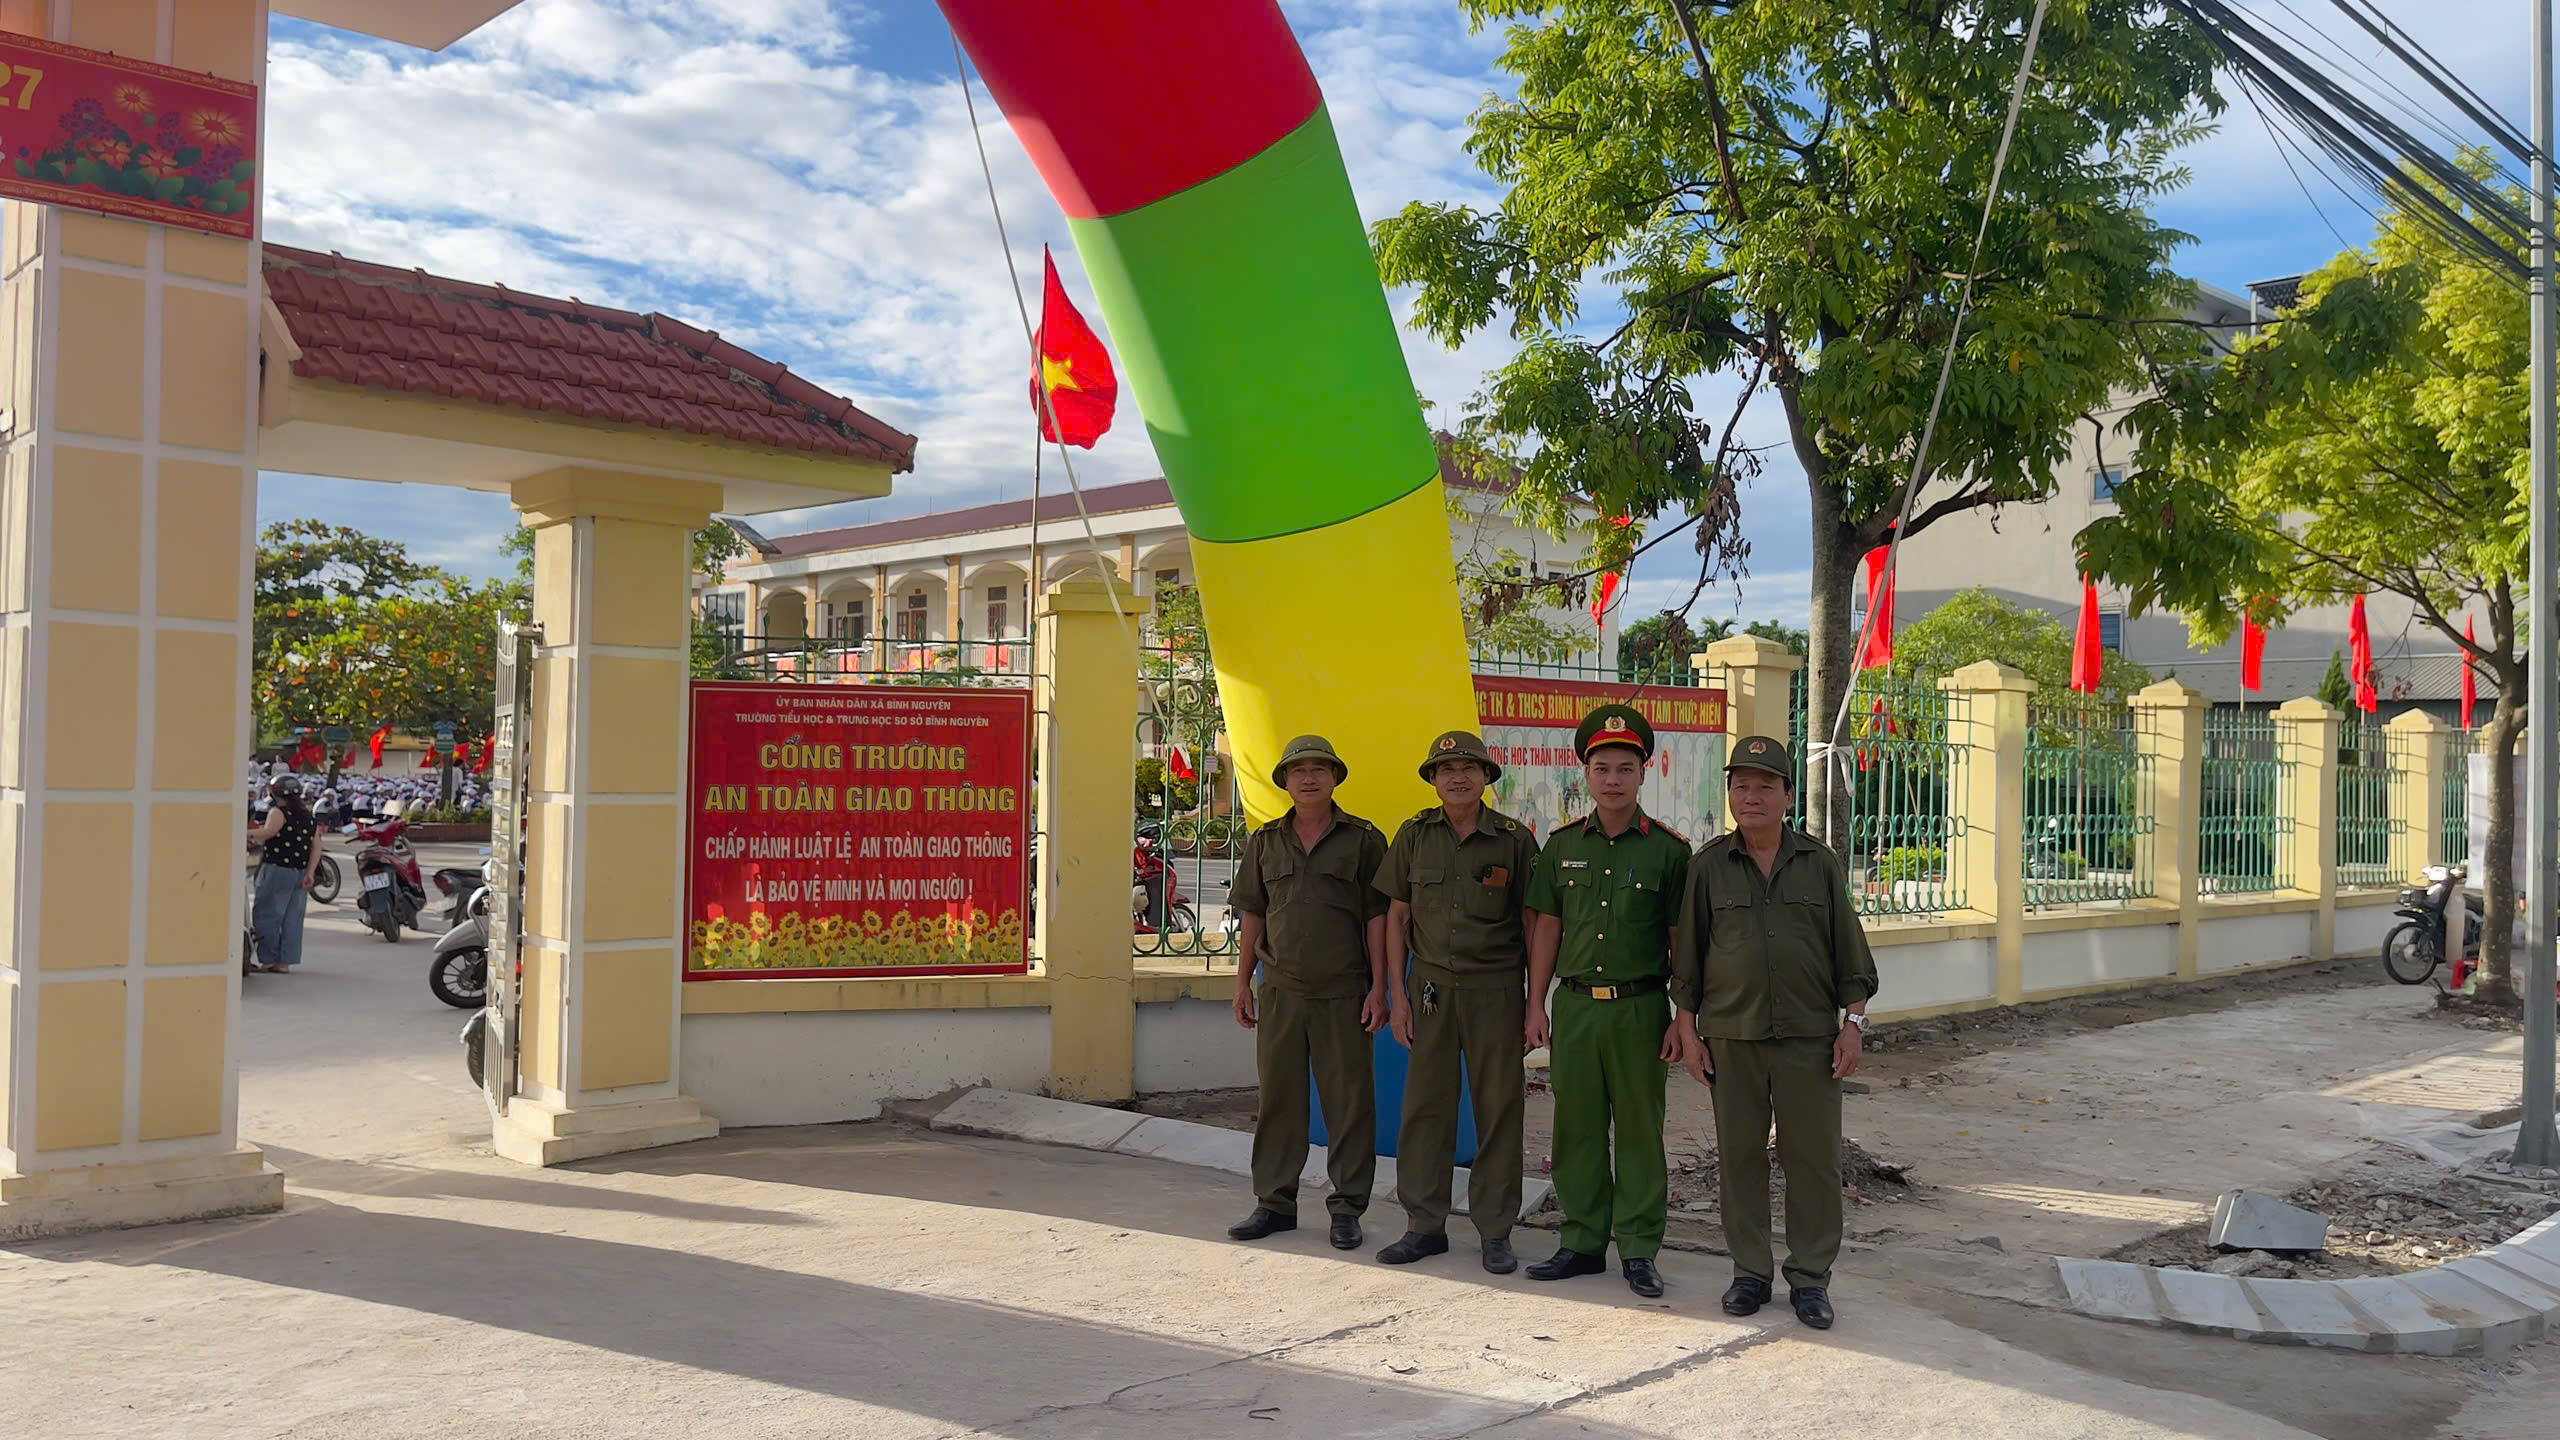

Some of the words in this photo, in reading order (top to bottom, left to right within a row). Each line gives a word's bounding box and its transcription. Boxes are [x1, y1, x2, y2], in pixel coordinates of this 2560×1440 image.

[793, 698, 814, 708] BAN
[816, 696, 844, 709] NHÂN
[846, 697, 868, 709] DÂN
[870, 698, 884, 709] XÃ
[887, 699, 909, 710] BÌNH
[911, 699, 951, 711] NGUYÊN
[1490, 691, 1503, 717] TH
[1506, 692, 1515, 718] &
[1518, 693, 1545, 720] THCS
[1548, 689, 1573, 720] BÌNH
[1651, 695, 1671, 724] TÂM
[1674, 699, 1697, 729] THỰC
[1700, 697, 1721, 730] HIỆN
[803, 715, 824, 727] HỌC
[826, 715, 834, 724] &
[836, 715, 870, 725] TRUNG
[871, 716, 892, 728] HỌC
[925, 715, 948, 727] BÌNH
[949, 715, 989, 728] NGUYÊN
[760, 734, 842, 770] CỔNG
[851, 738, 967, 771] TRƯỜNG
[1511, 746, 1528, 770] HỌC
[1530, 744, 1552, 767] THÂN
[704, 785, 747, 811] AN
[757, 780, 835, 811] TOÀN
[845, 786, 913, 812] GIAO
[922, 782, 1016, 812] THÔNG
[705, 827, 746, 859] CHẤP
[749, 831, 791, 859] HÀNH
[794, 830, 832, 865] LUẬT
[836, 830, 852, 865] LỆ
[859, 836, 881, 858] AN
[884, 830, 923, 858] TOÀN
[926, 836, 961, 858] GIAO
[965, 830, 1012, 858] THÔNG
[745, 874, 764, 903] LÀ
[768, 870, 799, 902] BẢO
[802, 873, 821, 908] VỆ
[825, 873, 862, 901] MÌNH
[865, 873, 886, 901] VÀ
[889, 879, 916, 907] MỌI
[920, 872, 964, 900] NGƯỜI
